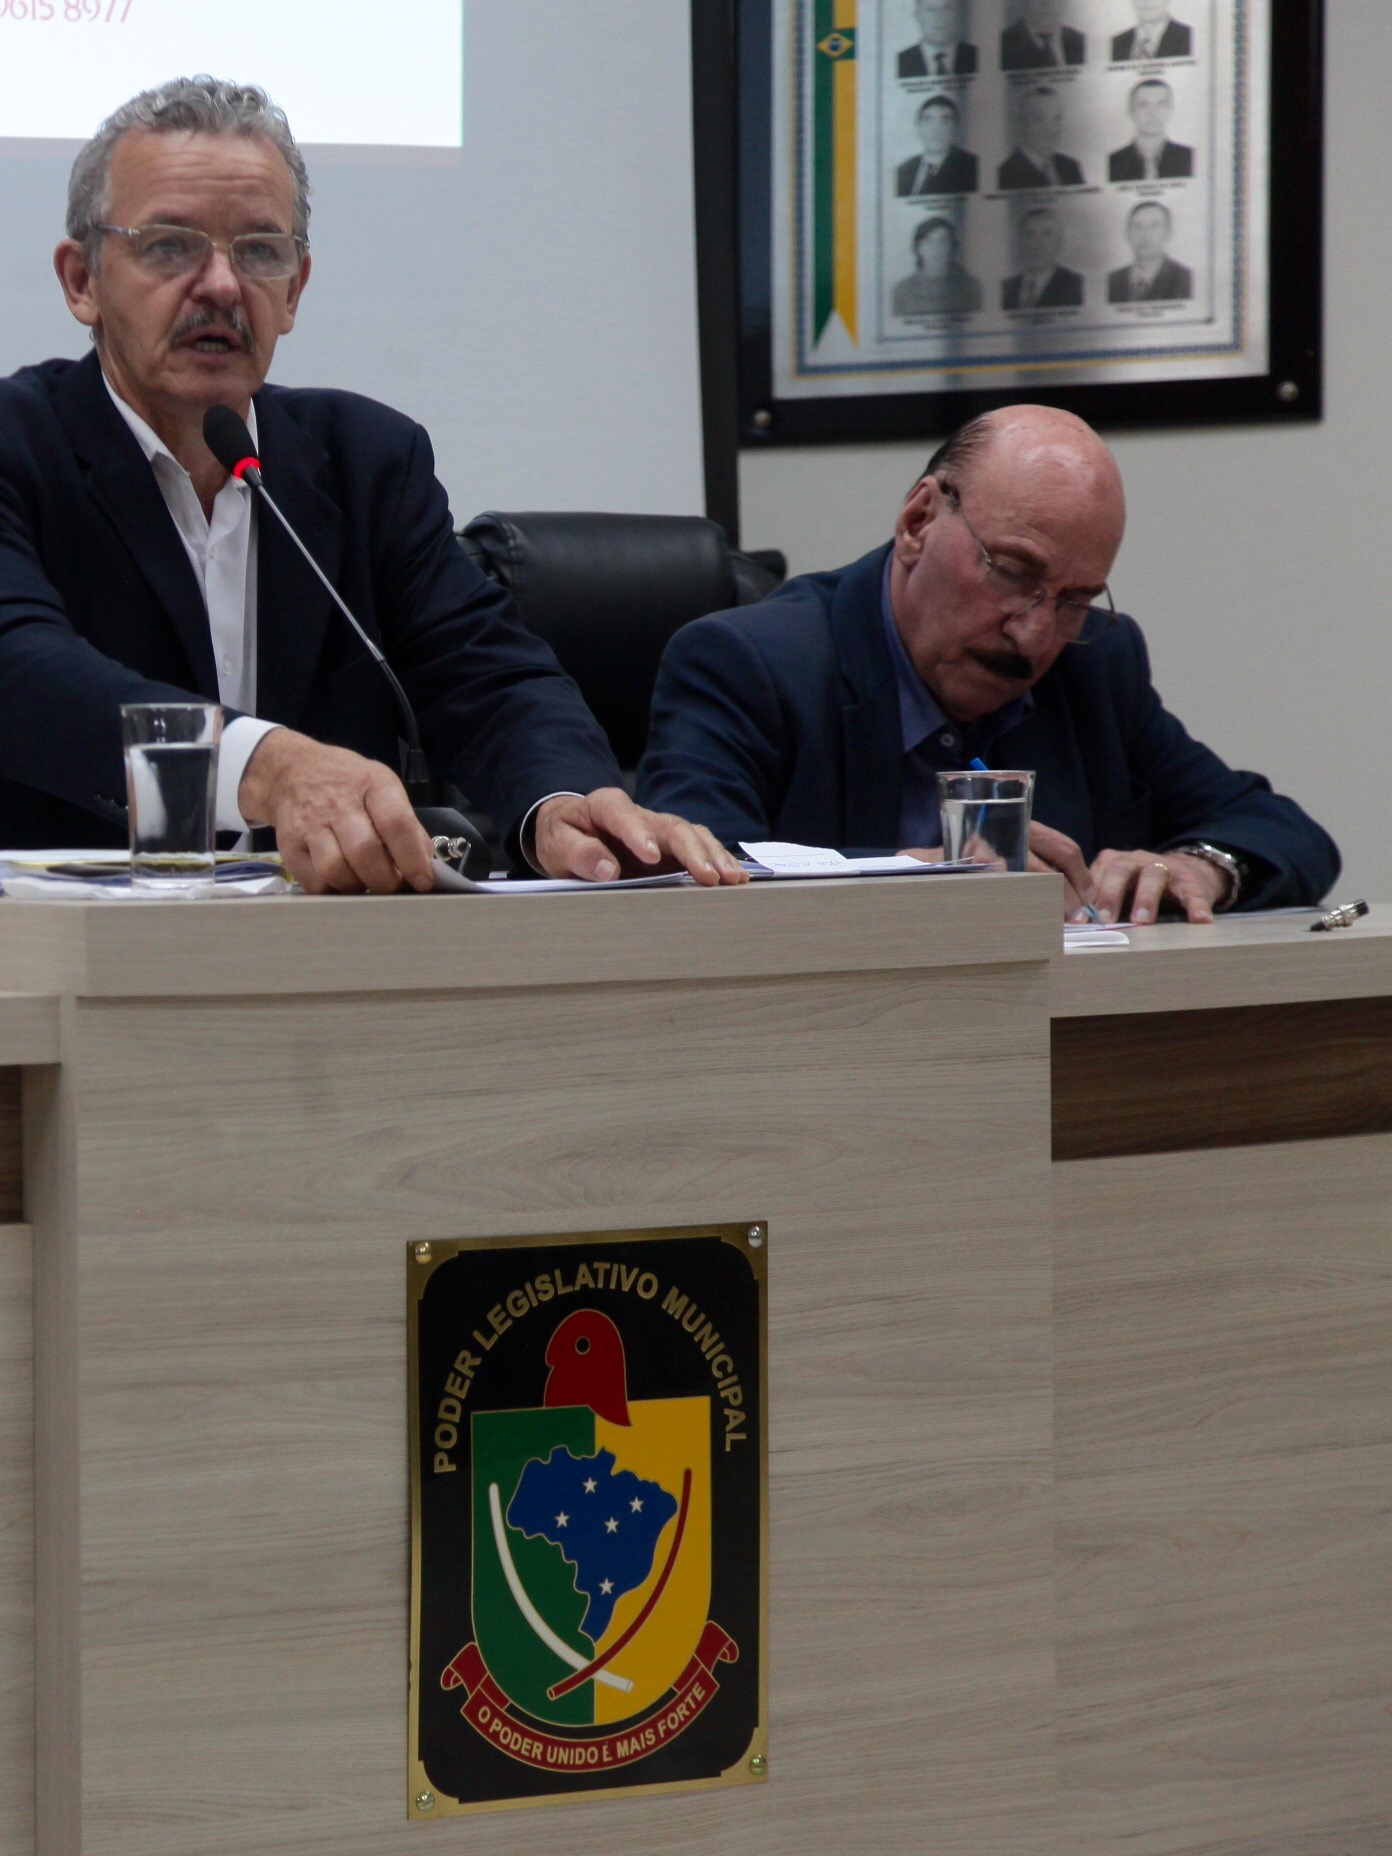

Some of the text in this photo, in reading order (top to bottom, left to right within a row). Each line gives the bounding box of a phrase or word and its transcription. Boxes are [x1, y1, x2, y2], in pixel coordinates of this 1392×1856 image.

[433, 1262, 747, 1474] PODER LEGISLATIVO MUNICIPAL
[477, 1705, 491, 1724] O
[489, 1717, 543, 1760] PODER
[546, 1745, 599, 1765] UNIDO
[616, 1728, 657, 1759] MAIS
[657, 1681, 706, 1740] FORTE
